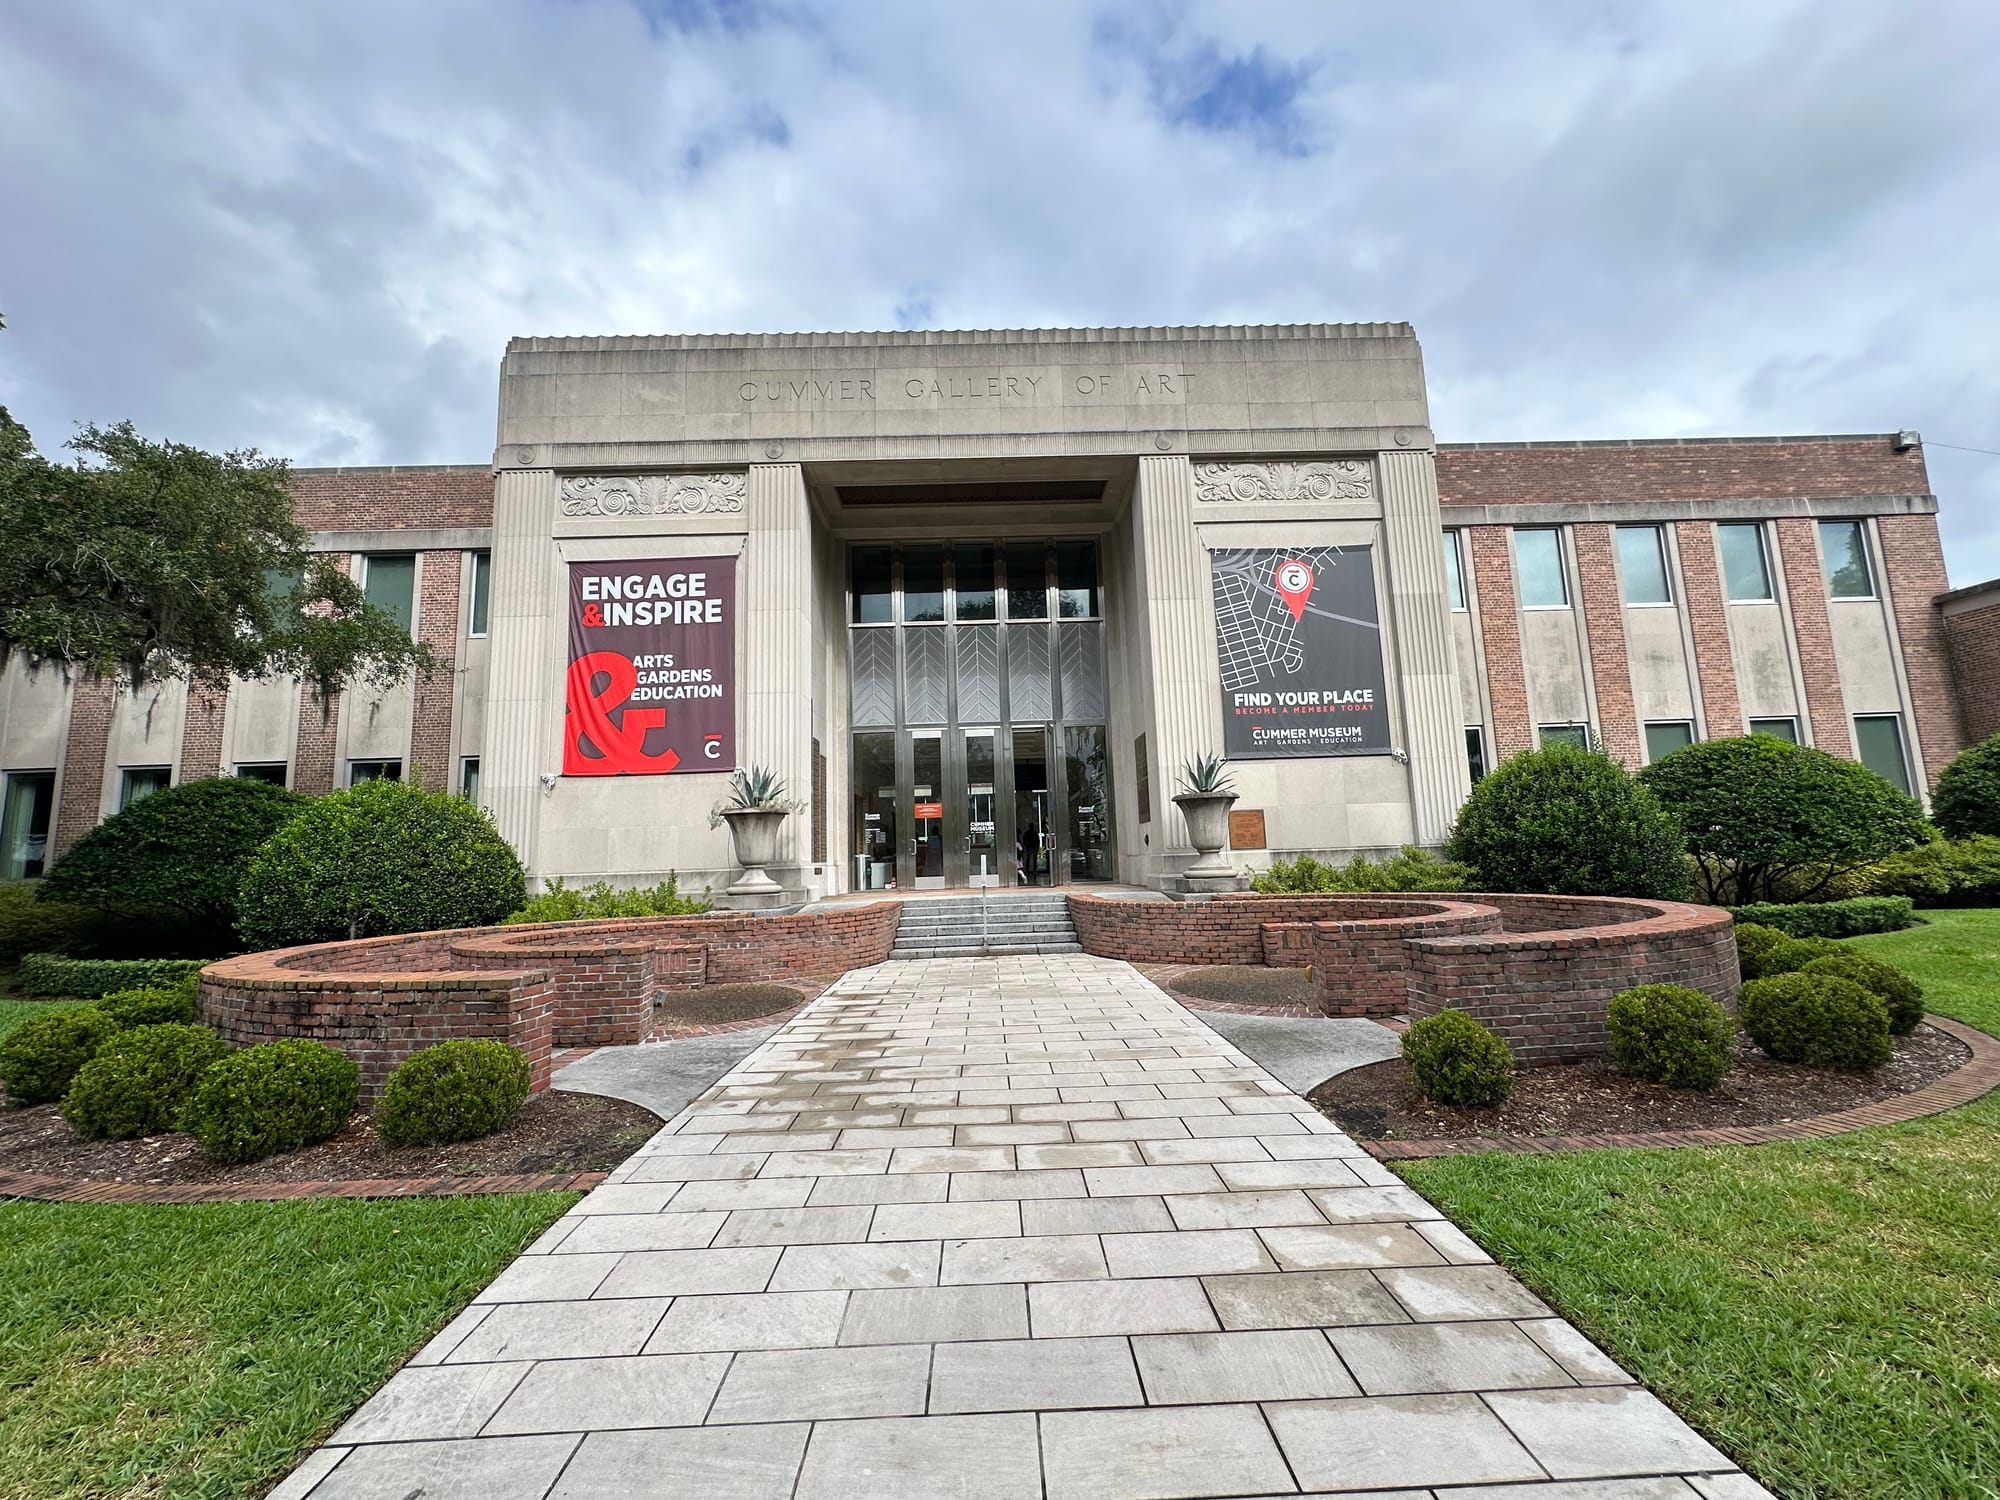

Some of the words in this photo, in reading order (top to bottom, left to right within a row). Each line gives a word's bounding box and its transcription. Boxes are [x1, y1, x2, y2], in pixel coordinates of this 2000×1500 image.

[739, 380, 877, 402] CUMMER
[905, 376, 1042, 398] GALLERY
[1076, 375, 1112, 395] OF
[1135, 374, 1196, 394] ART
[582, 573, 706, 600] ENGAGE
[633, 654, 674, 668] ARTS
[637, 668, 712, 684] GARDENS
[630, 684, 723, 701] EDUCATION
[1234, 693, 1272, 707] FIND
[1274, 691, 1320, 706] YOUR
[1322, 689, 1374, 704] PLACE
[1235, 707, 1277, 715] BECOME
[1282, 706, 1288, 714] A
[1293, 705, 1336, 713] MEMBER
[1341, 704, 1374, 712] TODAY
[1252, 729, 1307, 740] CUMMER
[1309, 726, 1361, 738] MUSEUM
[1320, 736, 1362, 744] EDUCATION
